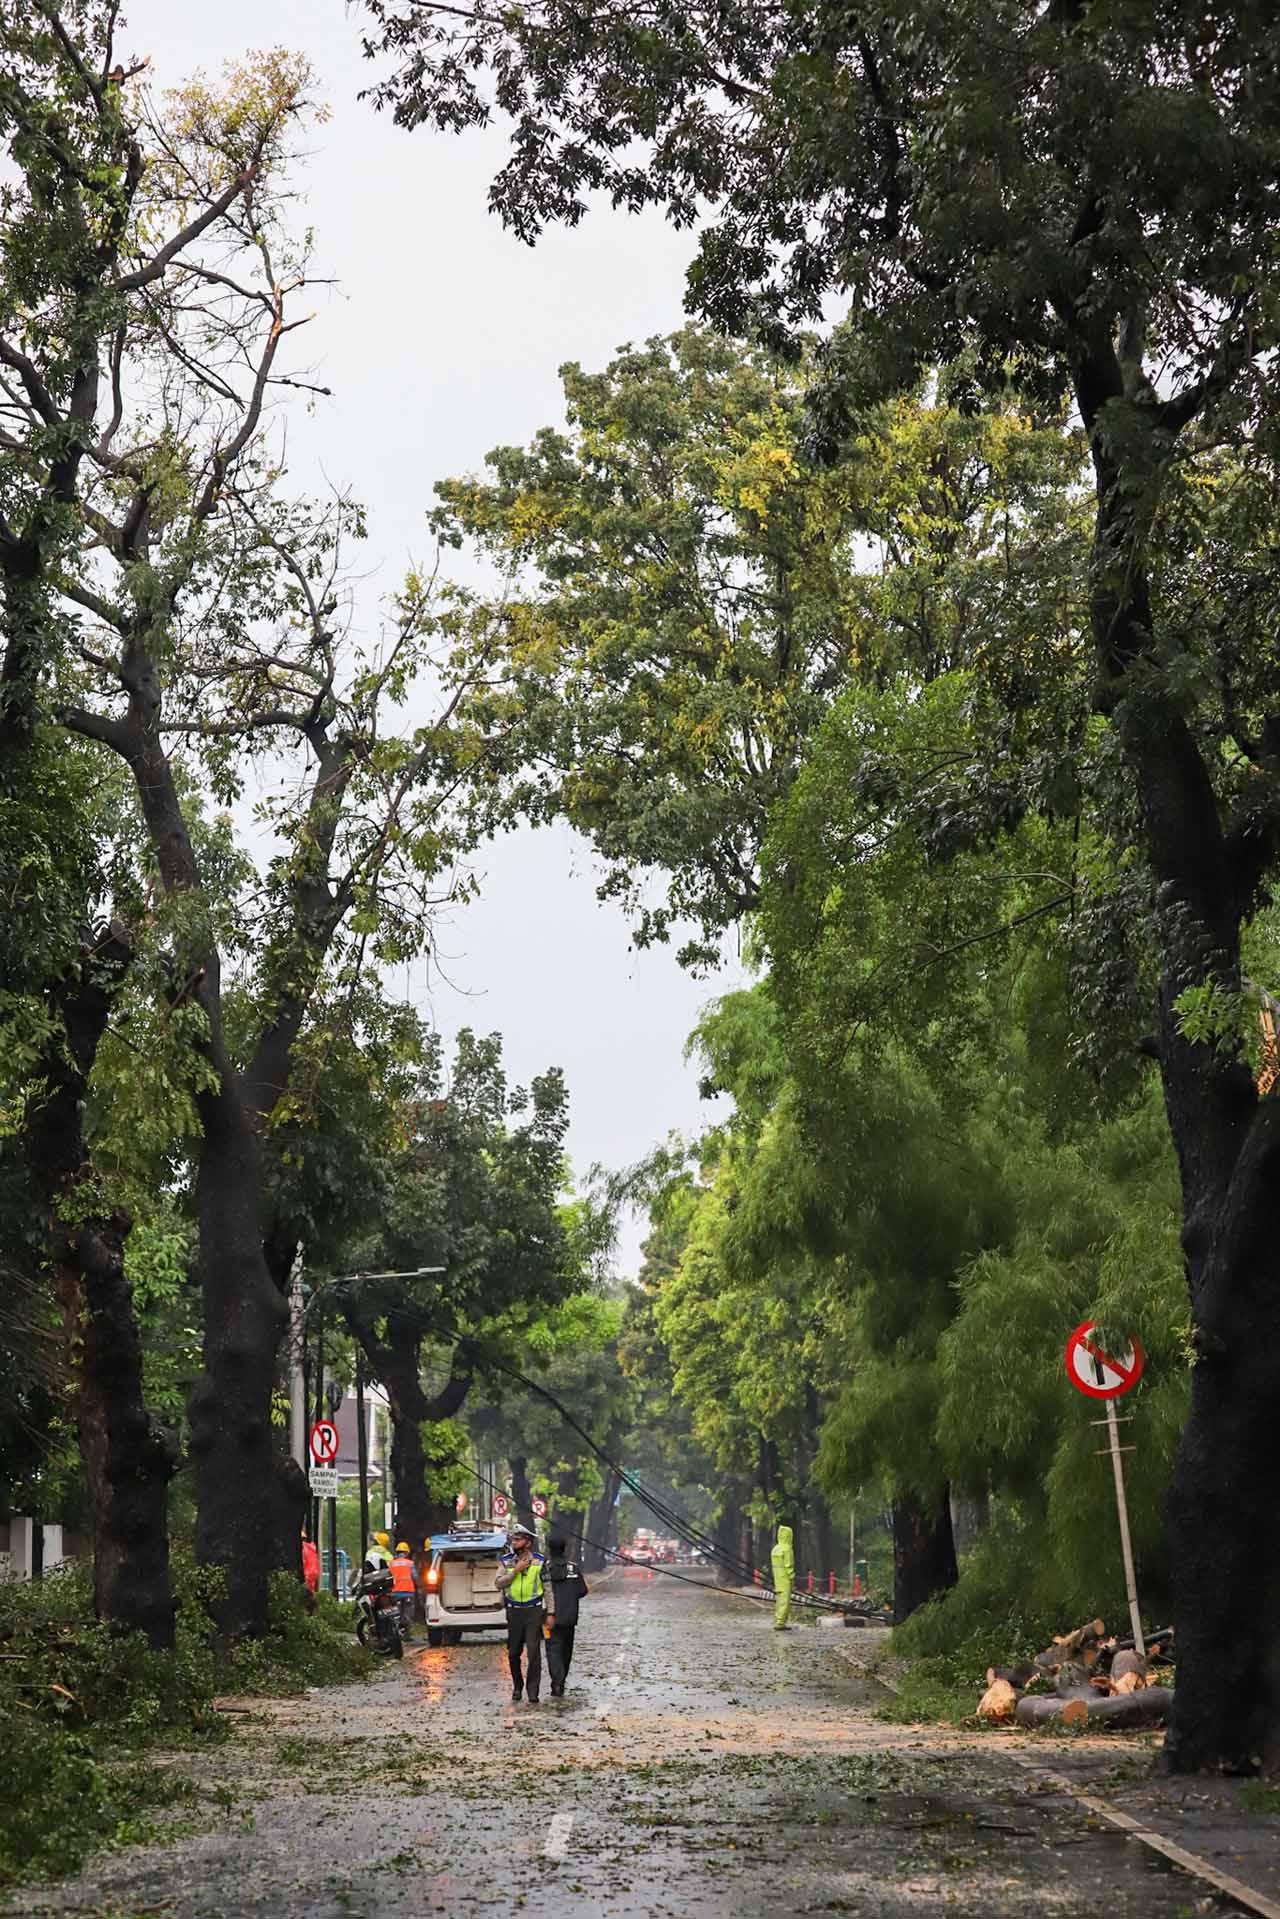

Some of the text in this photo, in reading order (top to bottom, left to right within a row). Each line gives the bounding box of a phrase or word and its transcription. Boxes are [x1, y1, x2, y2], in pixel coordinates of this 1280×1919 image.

[321, 1428, 332, 1455] P
[310, 1470, 337, 1478] SAMPAI
[312, 1487, 336, 1495] ERIKUT
